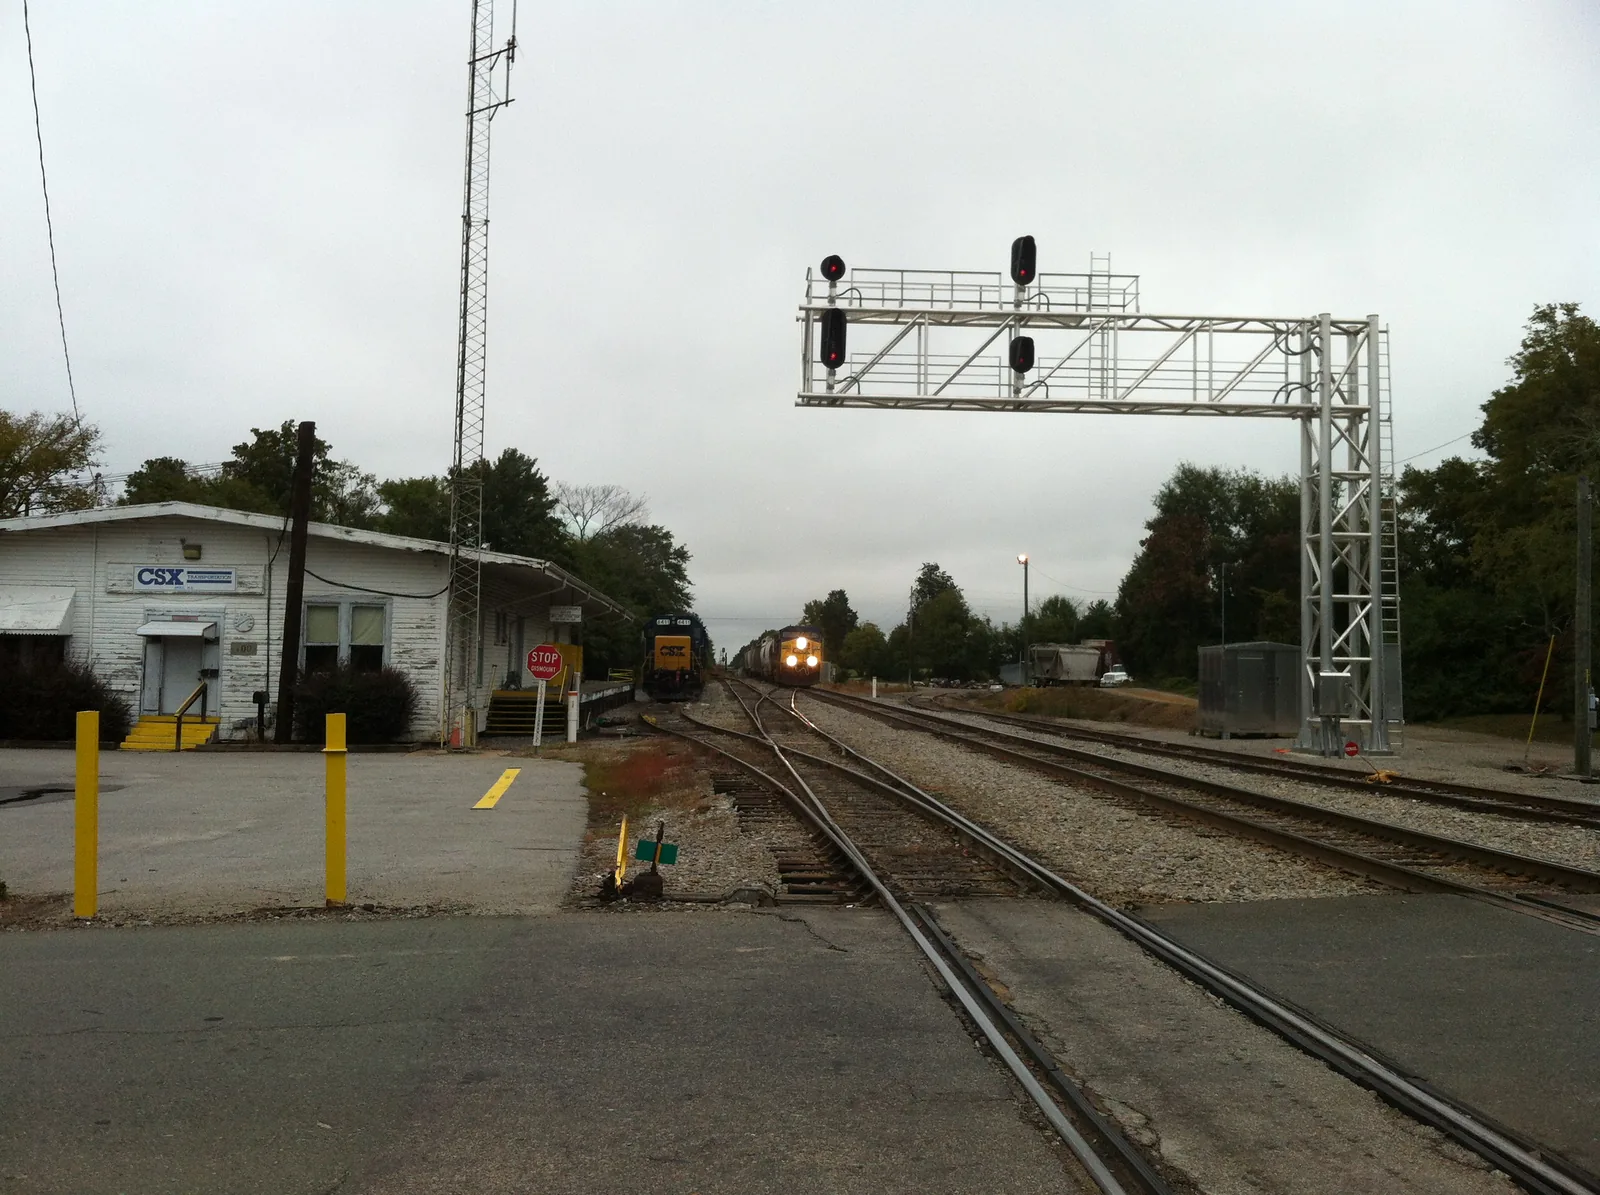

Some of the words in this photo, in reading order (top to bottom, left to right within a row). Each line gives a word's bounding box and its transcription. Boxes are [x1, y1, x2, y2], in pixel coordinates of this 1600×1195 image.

[137, 568, 184, 585] CSX
[660, 645, 686, 657] CSX
[531, 651, 558, 664] STOP
[530, 665, 556, 673] DISMOUNT
